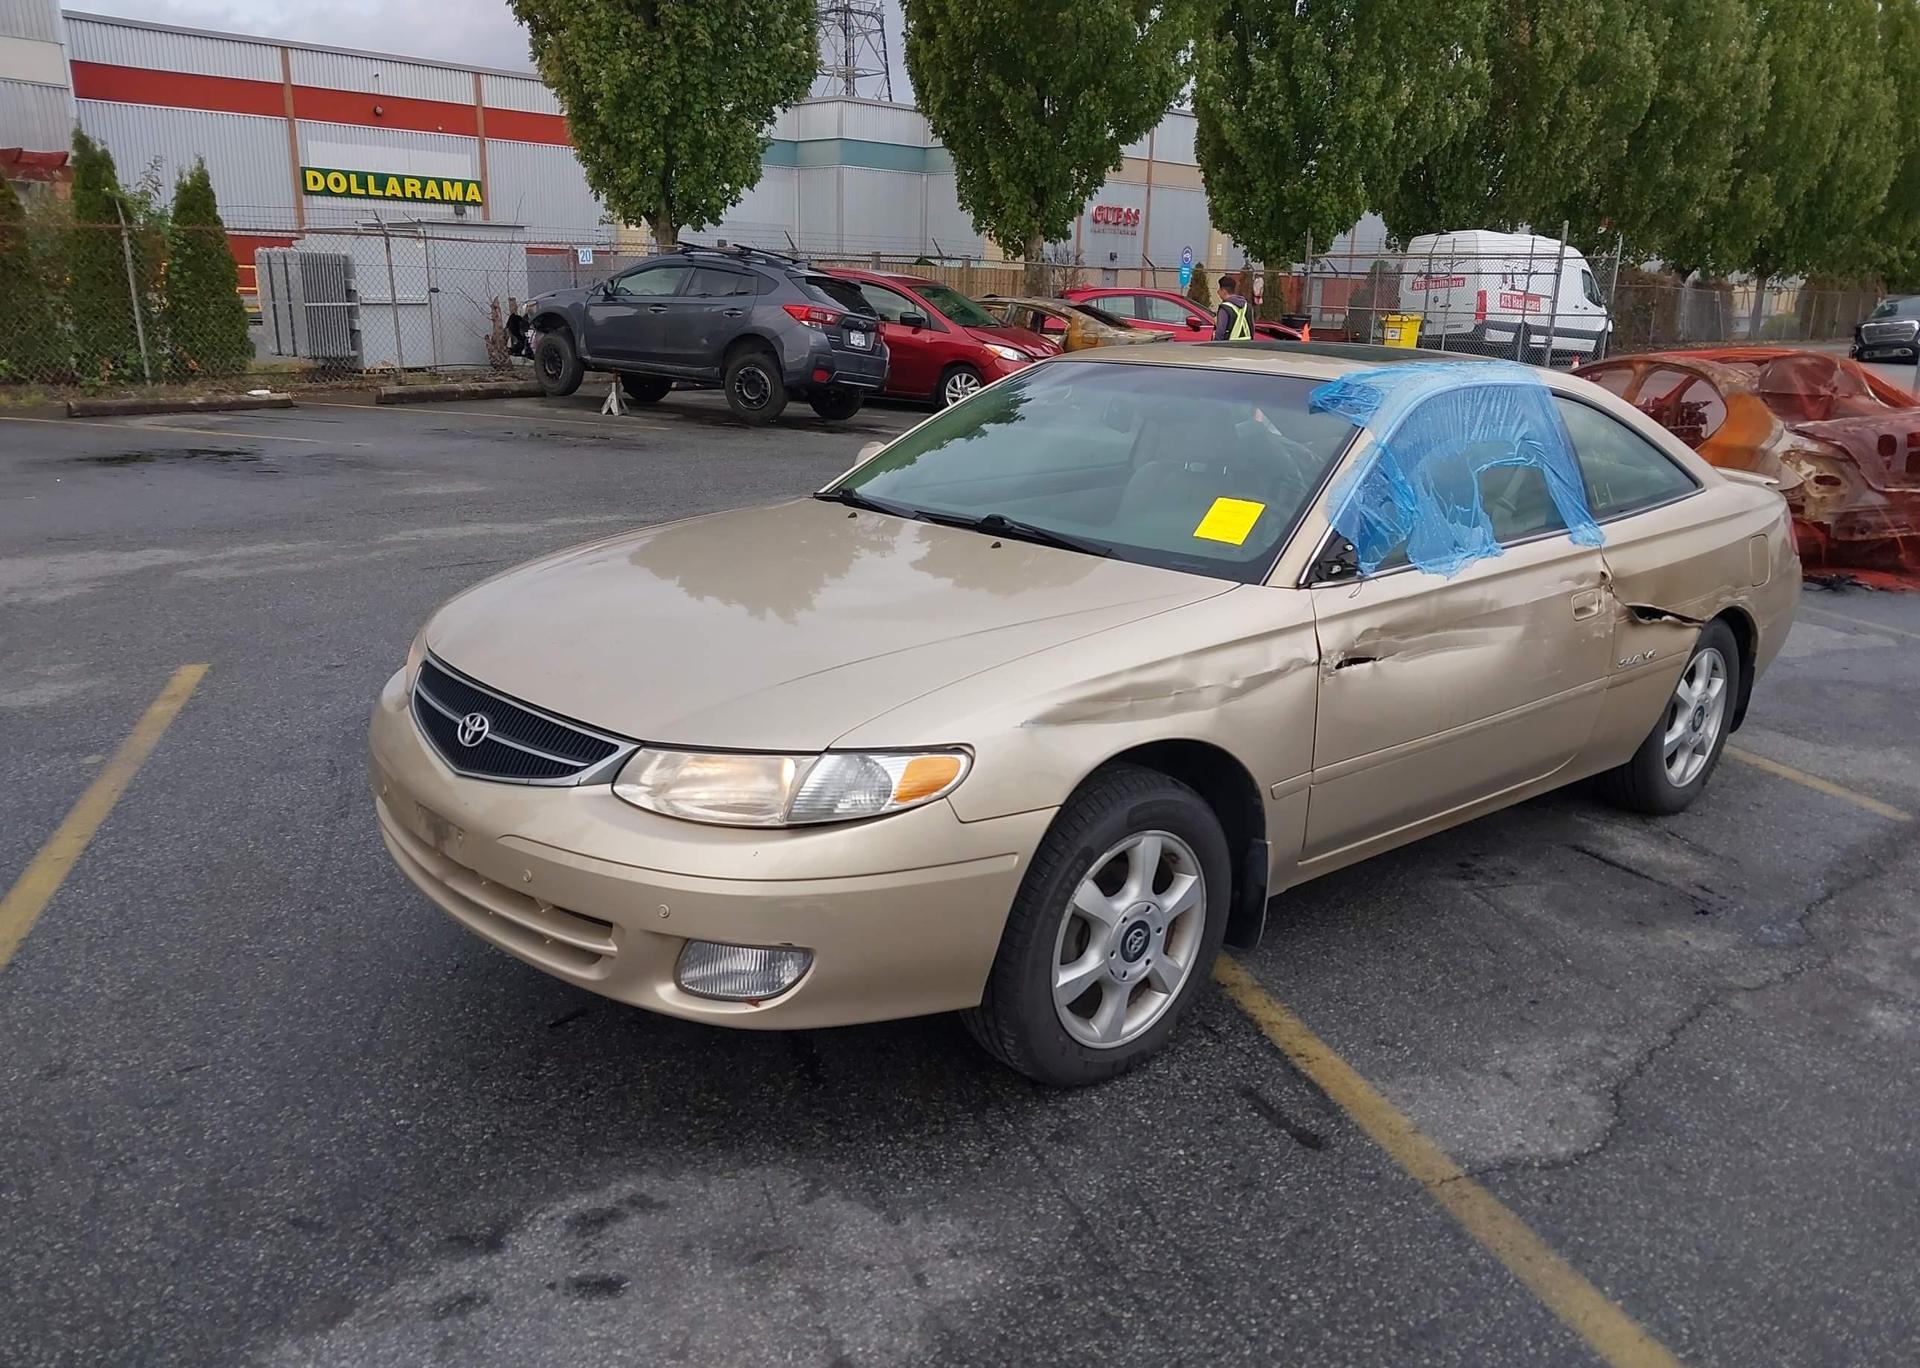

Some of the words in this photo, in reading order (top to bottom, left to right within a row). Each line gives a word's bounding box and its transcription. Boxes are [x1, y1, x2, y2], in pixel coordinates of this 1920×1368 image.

[305, 170, 482, 202] DOLLARAMA
[1094, 205, 1140, 226] GUESS
[579, 249, 591, 262] 20
[1414, 281, 1426, 290] ATS
[1502, 294, 1511, 307] ATS
